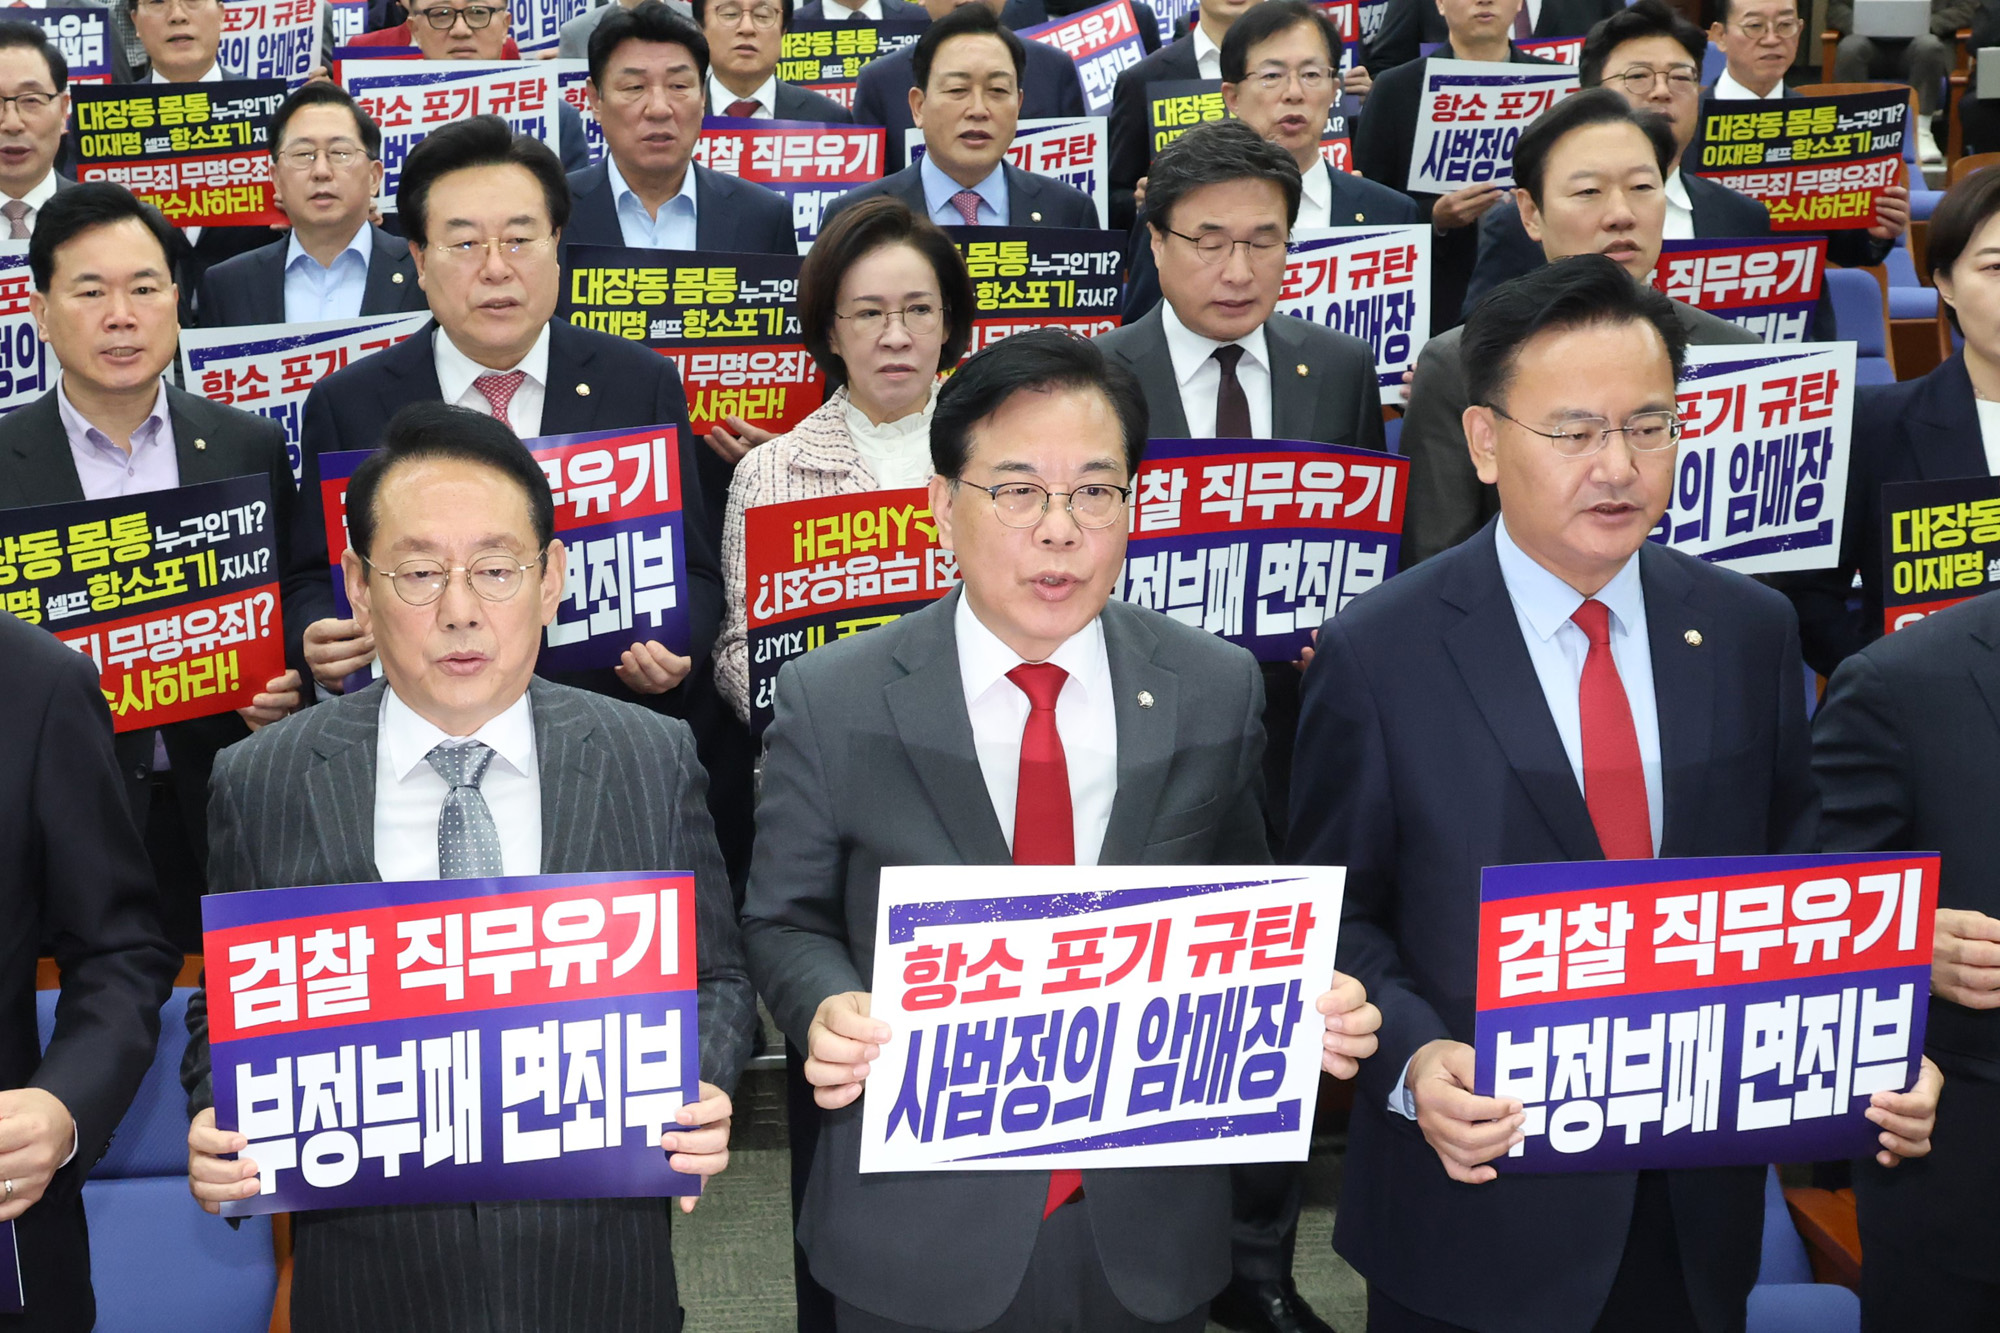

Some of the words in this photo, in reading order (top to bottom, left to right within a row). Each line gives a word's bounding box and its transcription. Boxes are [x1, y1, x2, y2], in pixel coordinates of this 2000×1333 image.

[835, 28, 878, 55] 몸통
[821, 65, 844, 79] 셀프
[77, 97, 156, 131] 대장동
[157, 92, 211, 126] 몸통
[421, 86, 480, 123] 포기
[488, 78, 548, 119] 규탄
[1152, 92, 1225, 128] 대장동
[1431, 93, 1488, 123] 항소
[1494, 88, 1555, 121] 포기
[1704, 111, 1784, 142] 대장동
[1785, 105, 1838, 137] 몸통
[1836, 103, 1906, 131] 누구인가?
[80, 132, 143, 157] 이재명
[144, 137, 172, 154] 셀프
[168, 121, 252, 151] 항소포기
[751, 133, 879, 178] 직무유기
[1040, 133, 1097, 171] 규탄
[1702, 142, 1765, 166] 이재명
[1764, 147, 1793, 163] 셀프
[1791, 130, 1872, 161] 항소포기
[1871, 131, 1903, 151] 지시?
[180, 155, 274, 189] 무명유죄
[1793, 157, 1900, 195] 무명유죄?
[965, 241, 1029, 278] 몸통
[1029, 250, 1121, 277] 누구인가?
[1348, 244, 1418, 290] 규탄
[1666, 246, 1818, 305] 직무유기
[571, 267, 670, 305] 대장동
[671, 267, 738, 304] 몸통
[976, 279, 1075, 311] 항소포기
[1076, 287, 1118, 307] 지시?
[570, 310, 647, 340] 이재명
[649, 319, 682, 339] 셀프
[682, 307, 784, 339] 항소포기
[202, 364, 270, 405] 항소
[281, 346, 348, 395] 포기
[687, 350, 817, 387] 무명유죄?
[687, 387, 786, 423] 사하라!
[1675, 384, 1747, 440] 포기
[1758, 369, 1839, 428] 규탄
[538, 437, 669, 518] 유기
[1200, 461, 1397, 523] 직무유기
[1725, 426, 1834, 538] 암매장
[66, 511, 152, 573] 몸통
[154, 500, 267, 554] 누구인가?
[1891, 497, 2000, 554] 대장동
[45, 590, 91, 621] 셀프
[86, 549, 219, 612] 항소포기
[220, 547, 271, 583] 지시?
[547, 525, 677, 648] 면죄부
[752, 550, 920, 620] 무명유죄?
[1893, 550, 1985, 595] 이재명
[107, 591, 275, 670] 무명유죄?
[754, 630, 804, 664] 지시?
[1498, 900, 1636, 1000] 검찰
[1652, 867, 1924, 978] 직무유기
[228, 925, 376, 1031] 검찰
[396, 888, 680, 1002] 직무유기
[900, 938, 1025, 1013] 항소
[1040, 917, 1173, 996] 포기
[1186, 901, 1318, 979] 규탄
[884, 1001, 1122, 1145] 사법정의
[1126, 978, 1304, 1118] 암매장
[1494, 1003, 1727, 1159] 부정부패
[1735, 982, 1916, 1133] 면죄부
[235, 1028, 484, 1197] 부정부패
[501, 1008, 685, 1165] 면죄부
